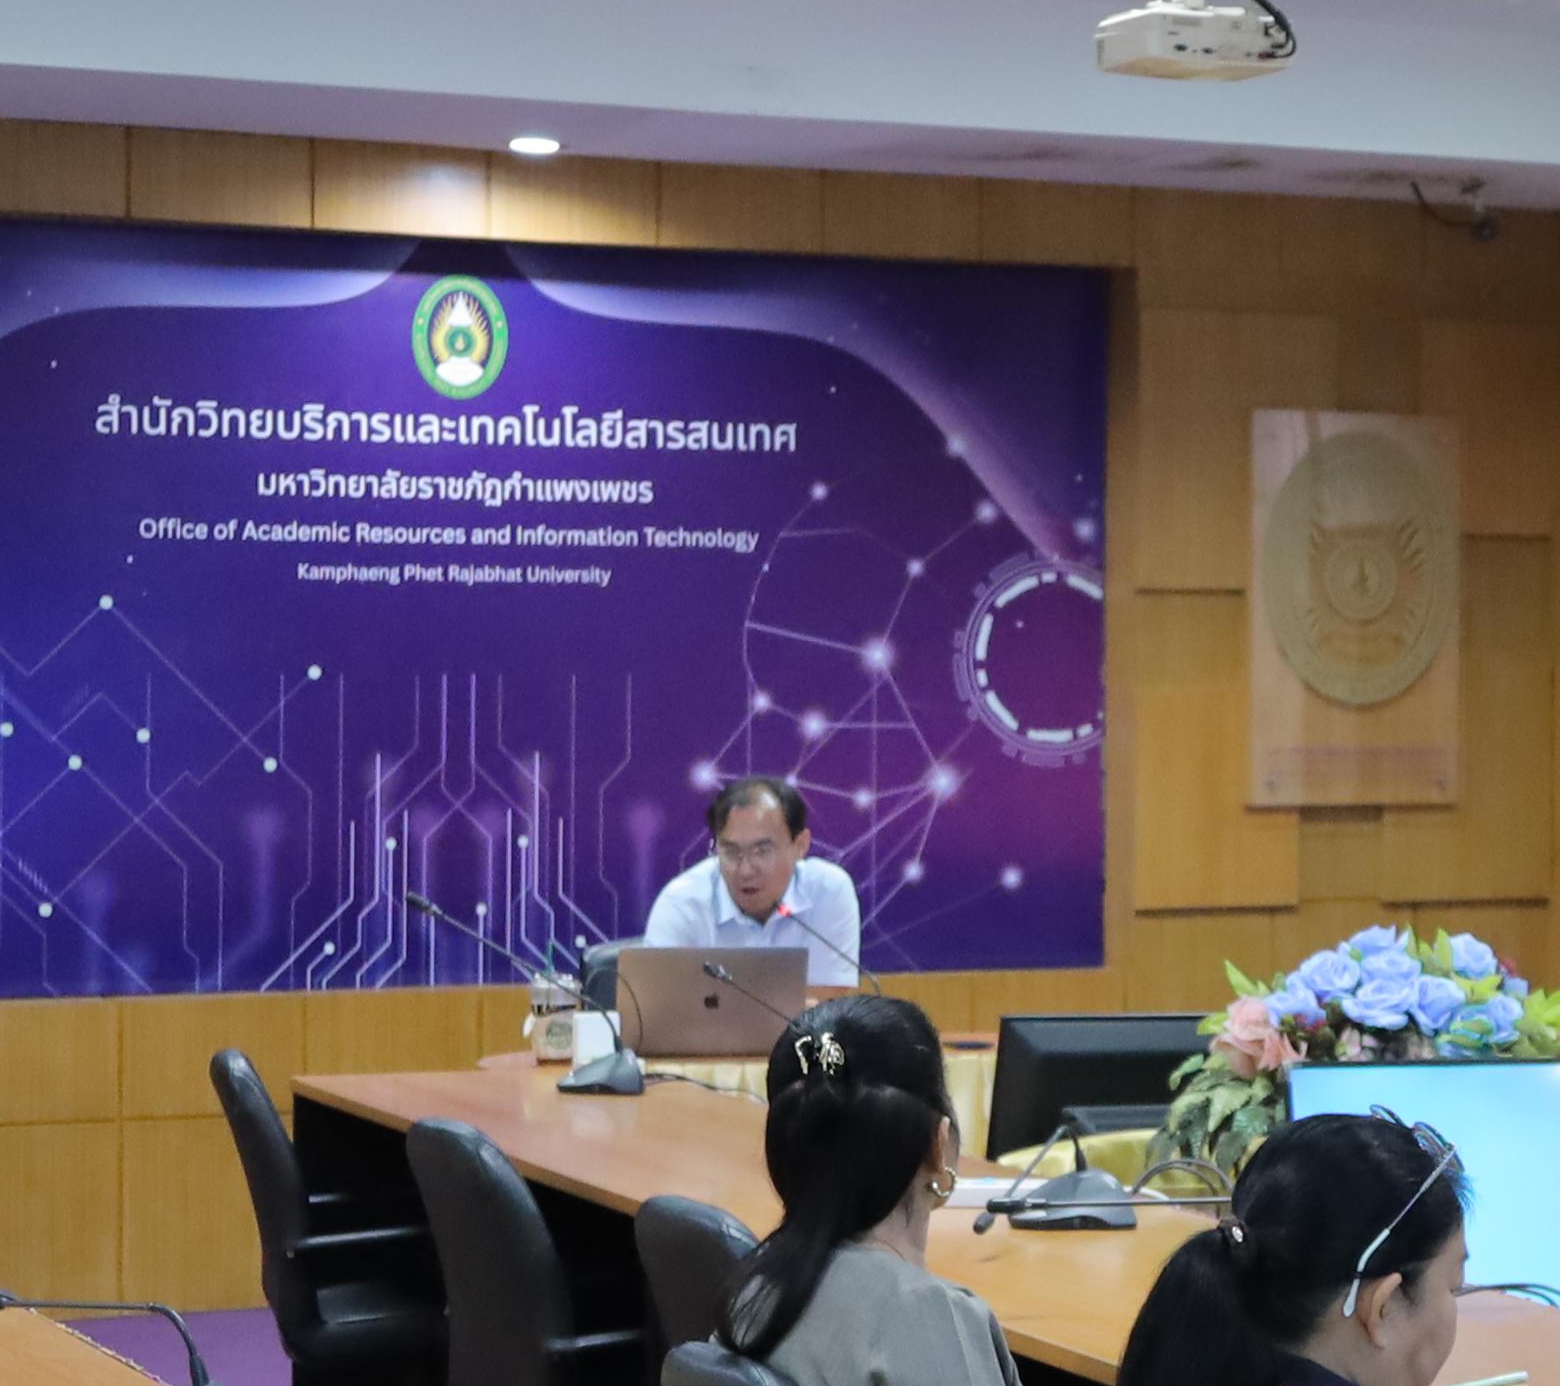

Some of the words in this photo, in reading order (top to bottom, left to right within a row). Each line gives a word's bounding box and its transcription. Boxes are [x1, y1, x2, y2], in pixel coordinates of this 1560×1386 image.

[94, 393, 798, 452] สำนักวิทยบริการและเทคโนโลยีสารสนเทศ
[256, 468, 654, 507] มหาวิทยาลัยราชภัฏกำแพงเพชร
[138, 516, 208, 542] Office
[213, 518, 239, 542] of
[241, 520, 351, 544] Academic
[355, 522, 467, 546] Resources
[470, 524, 511, 547] and
[515, 524, 639, 549] Information
[643, 526, 760, 554] Technology
[296, 562, 401, 586] Kamphaeng
[403, 564, 445, 584] Phet
[448, 564, 523, 588] Rajabhat
[526, 565, 613, 589] University
